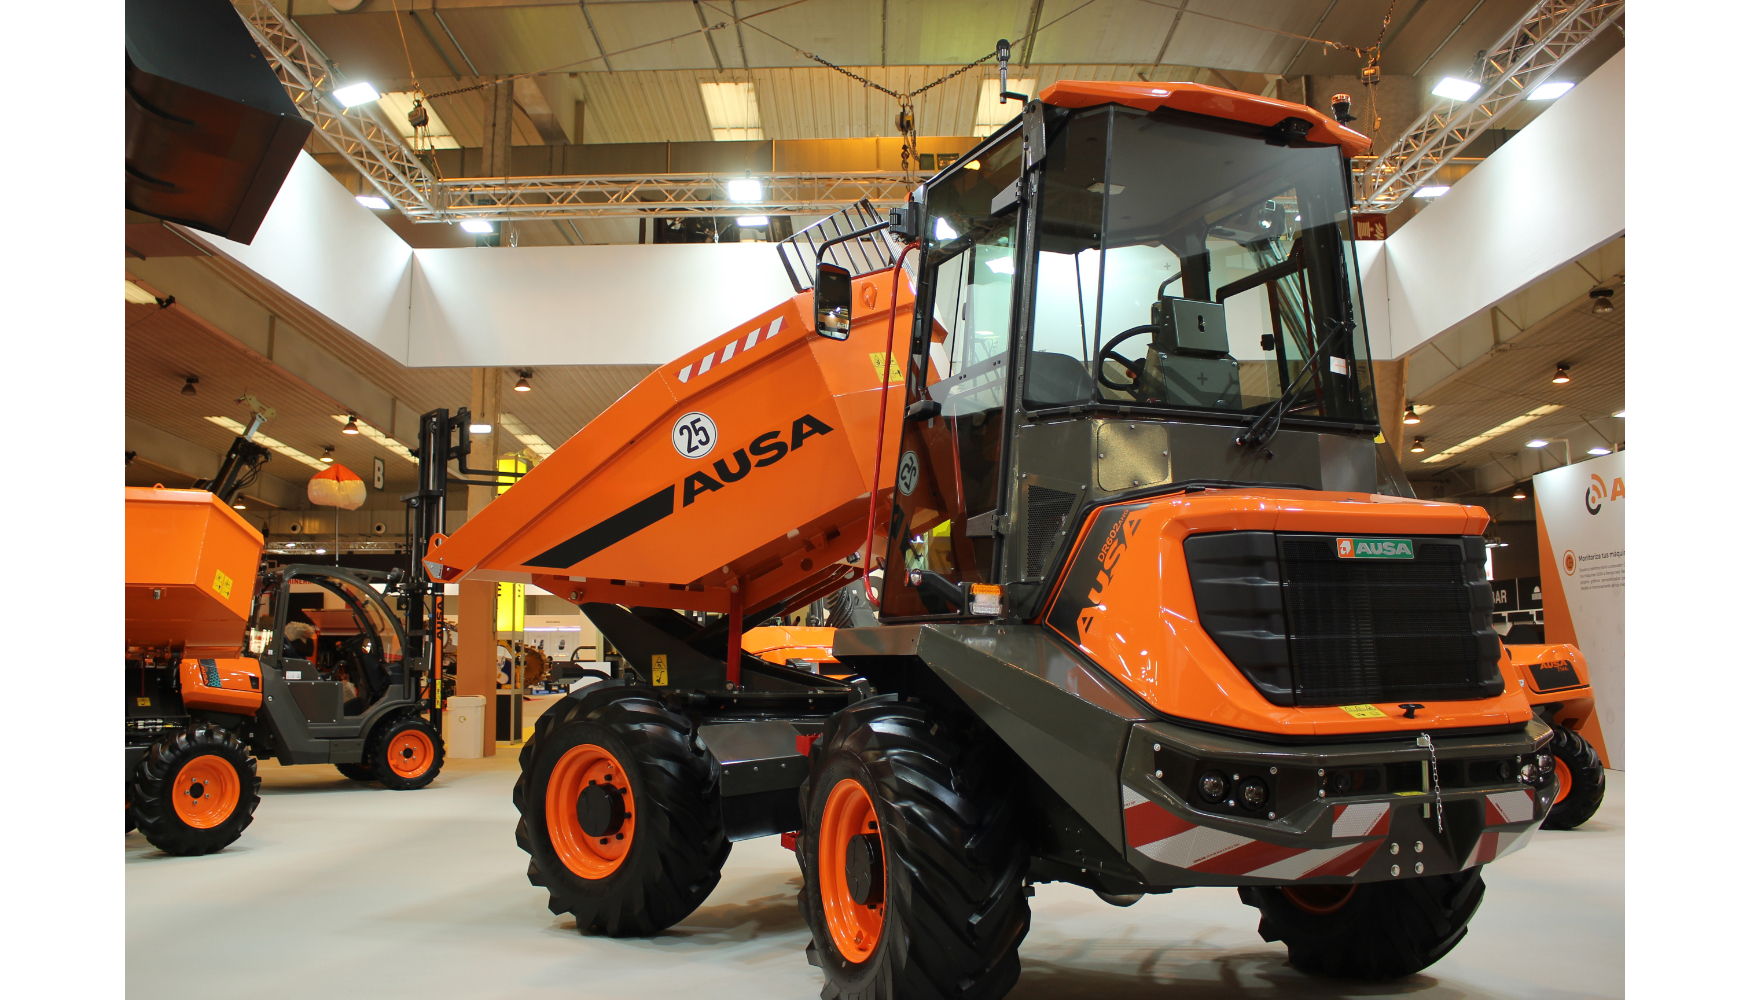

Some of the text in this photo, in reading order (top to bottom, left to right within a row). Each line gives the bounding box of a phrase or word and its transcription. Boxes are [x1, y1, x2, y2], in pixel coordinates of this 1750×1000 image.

[679, 417, 710, 454] 25
[374, 458, 384, 489] B
[683, 414, 834, 508] AUSA
[1356, 541, 1412, 556] AUSA
[1077, 510, 1143, 646] AUSA
[1540, 659, 1568, 670] AUSA
